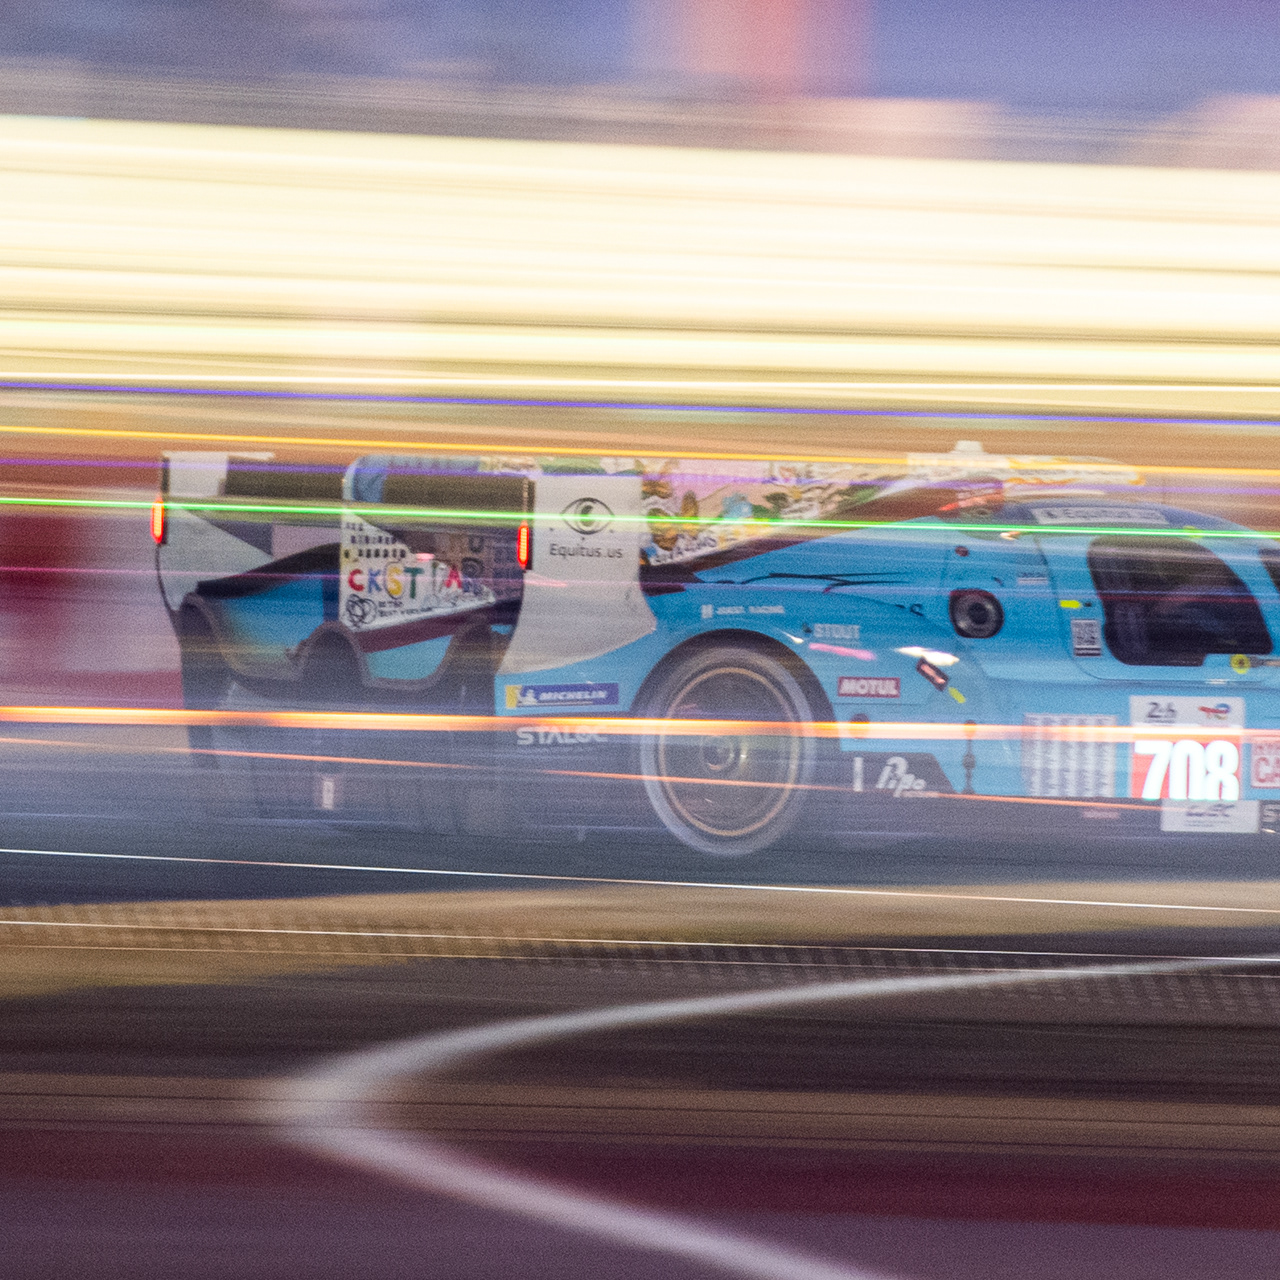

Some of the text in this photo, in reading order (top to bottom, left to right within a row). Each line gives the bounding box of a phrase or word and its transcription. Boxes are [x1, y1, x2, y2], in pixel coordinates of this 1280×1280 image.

[549, 543, 624, 559] Equitus.us
[839, 678, 898, 695] MOTUL
[539, 690, 608, 701] MICHELIN
[516, 724, 608, 746] STALOC
[1133, 739, 1240, 801] 708
